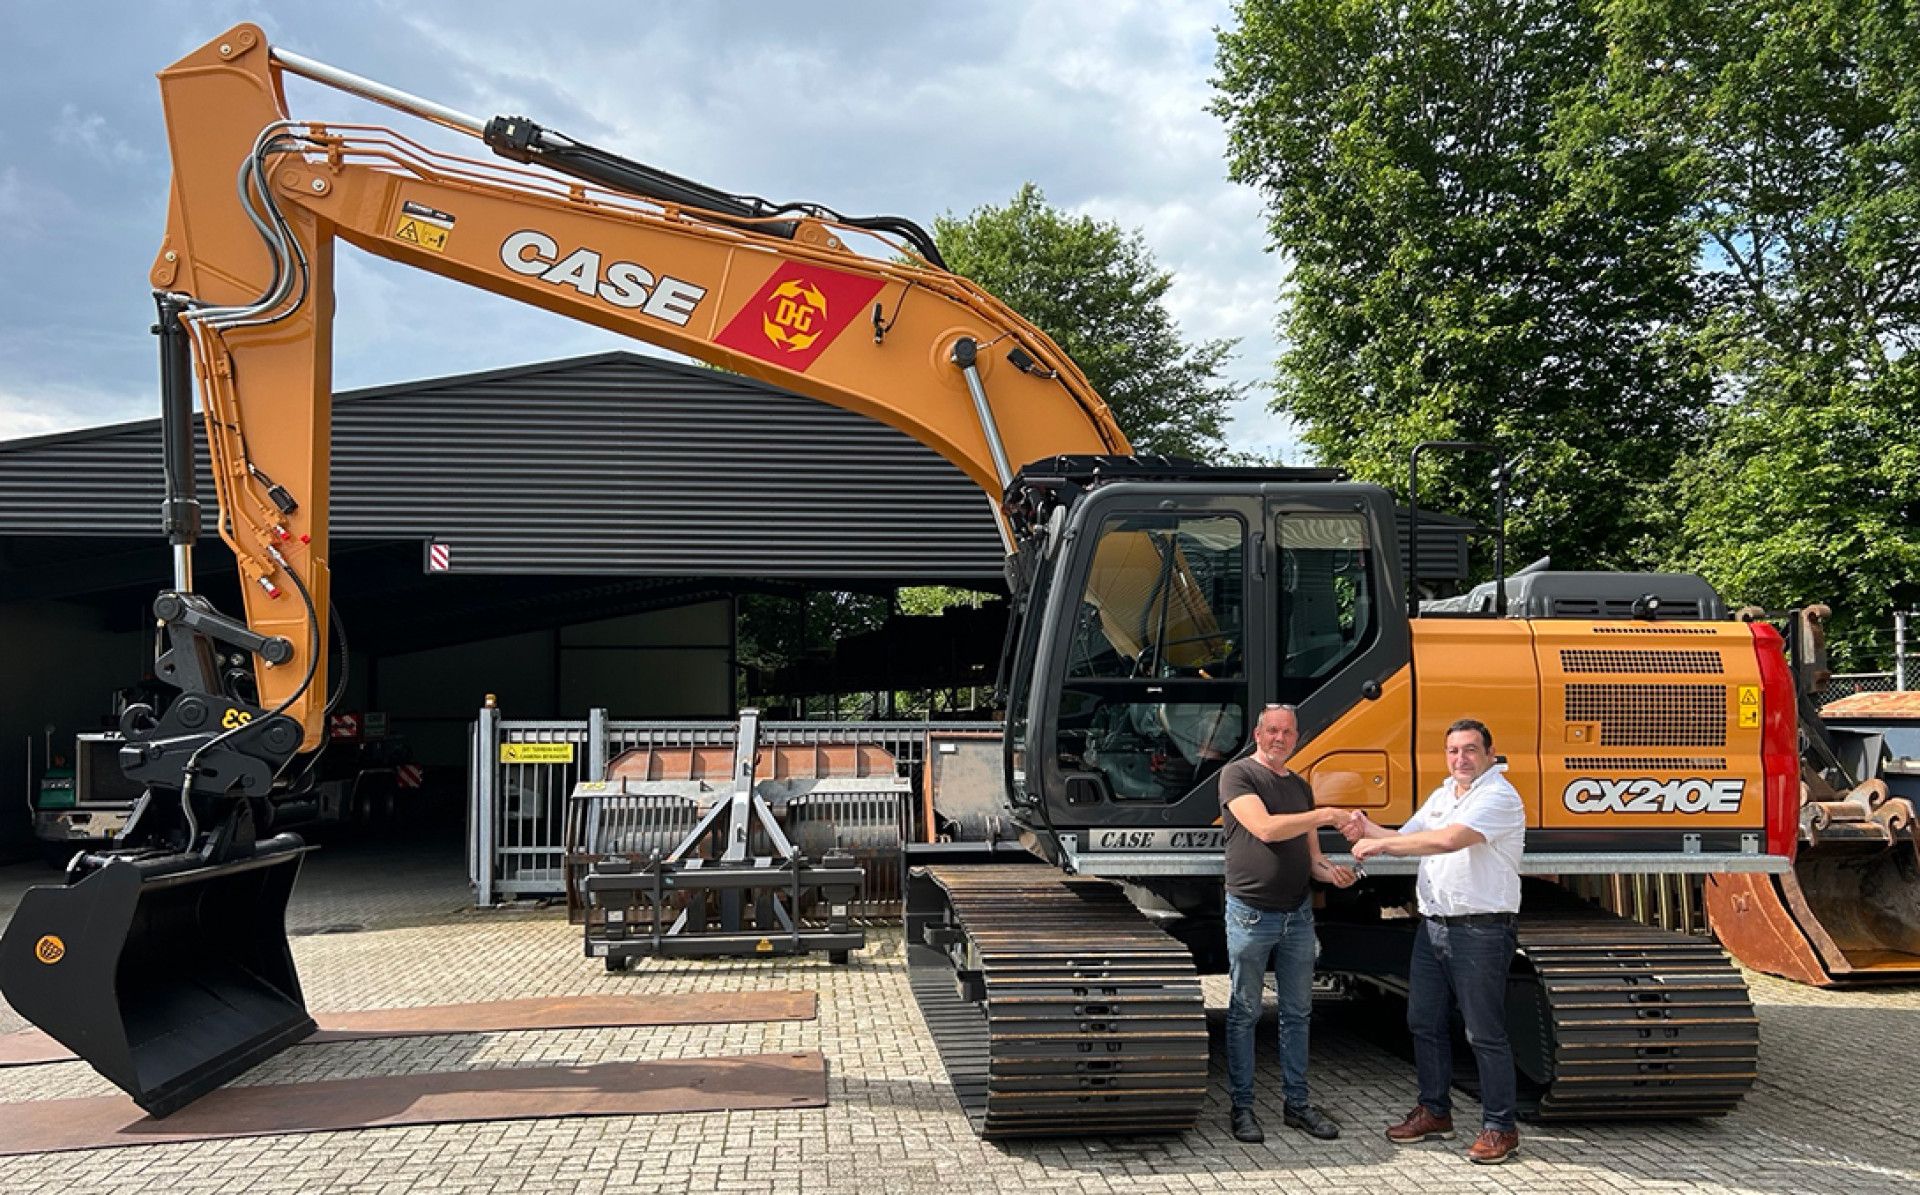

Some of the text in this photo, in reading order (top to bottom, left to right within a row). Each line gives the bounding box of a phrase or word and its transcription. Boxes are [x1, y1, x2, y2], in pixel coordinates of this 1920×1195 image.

[499, 228, 709, 328] CASE
[1562, 777, 1746, 814] CX210E
[1101, 831, 1155, 849] CASE
